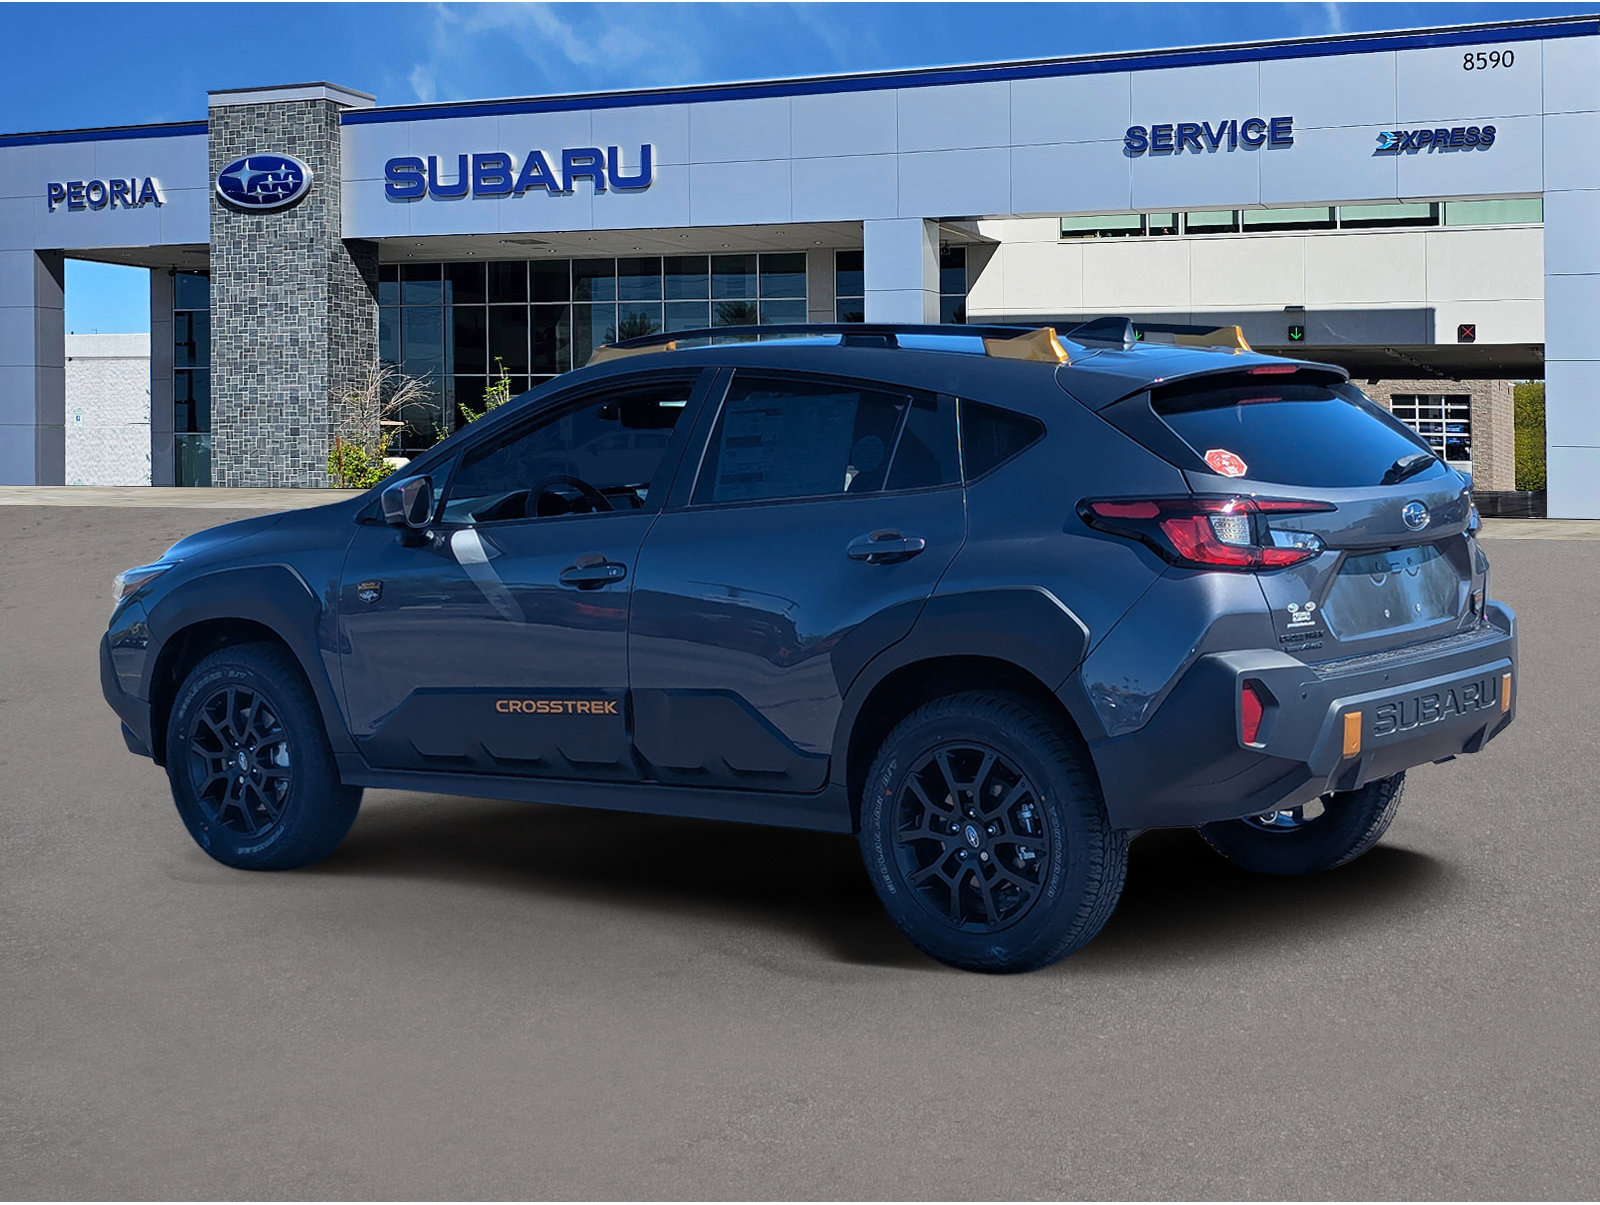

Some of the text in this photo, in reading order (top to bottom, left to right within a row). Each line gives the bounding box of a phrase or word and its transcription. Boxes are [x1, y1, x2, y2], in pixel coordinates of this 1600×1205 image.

[1463, 50, 1515, 71] 8590
[1125, 116, 1294, 153] SERVICE
[1375, 125, 1497, 151] EXPRESS
[384, 144, 652, 201] SUBARU
[47, 177, 162, 212] PEORIA
[495, 700, 618, 714] CROSSTREK
[1374, 677, 1497, 737] SUBARU
